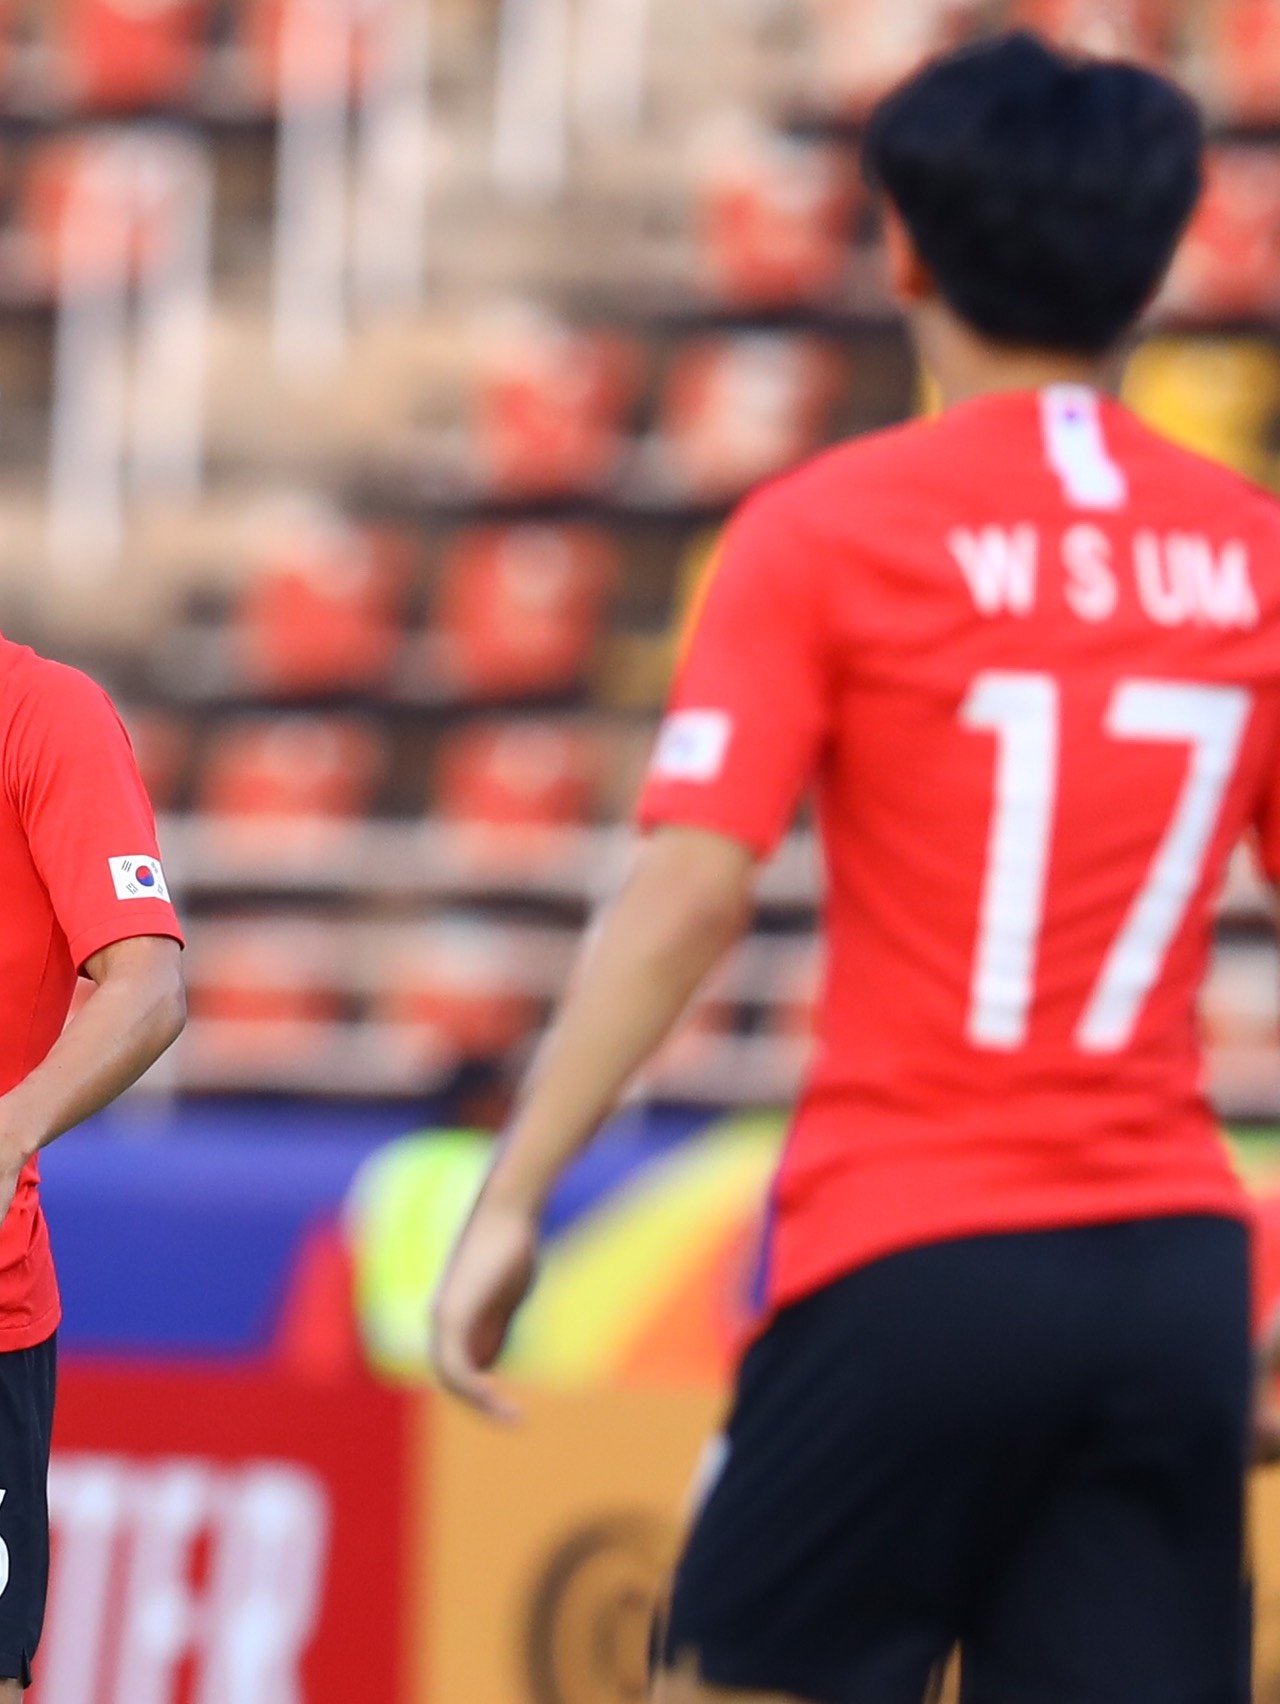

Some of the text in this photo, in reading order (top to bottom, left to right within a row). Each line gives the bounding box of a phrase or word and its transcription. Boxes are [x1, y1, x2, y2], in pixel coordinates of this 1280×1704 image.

[946, 520, 1261, 632] W S UM
[959, 669, 1253, 1054] 17
